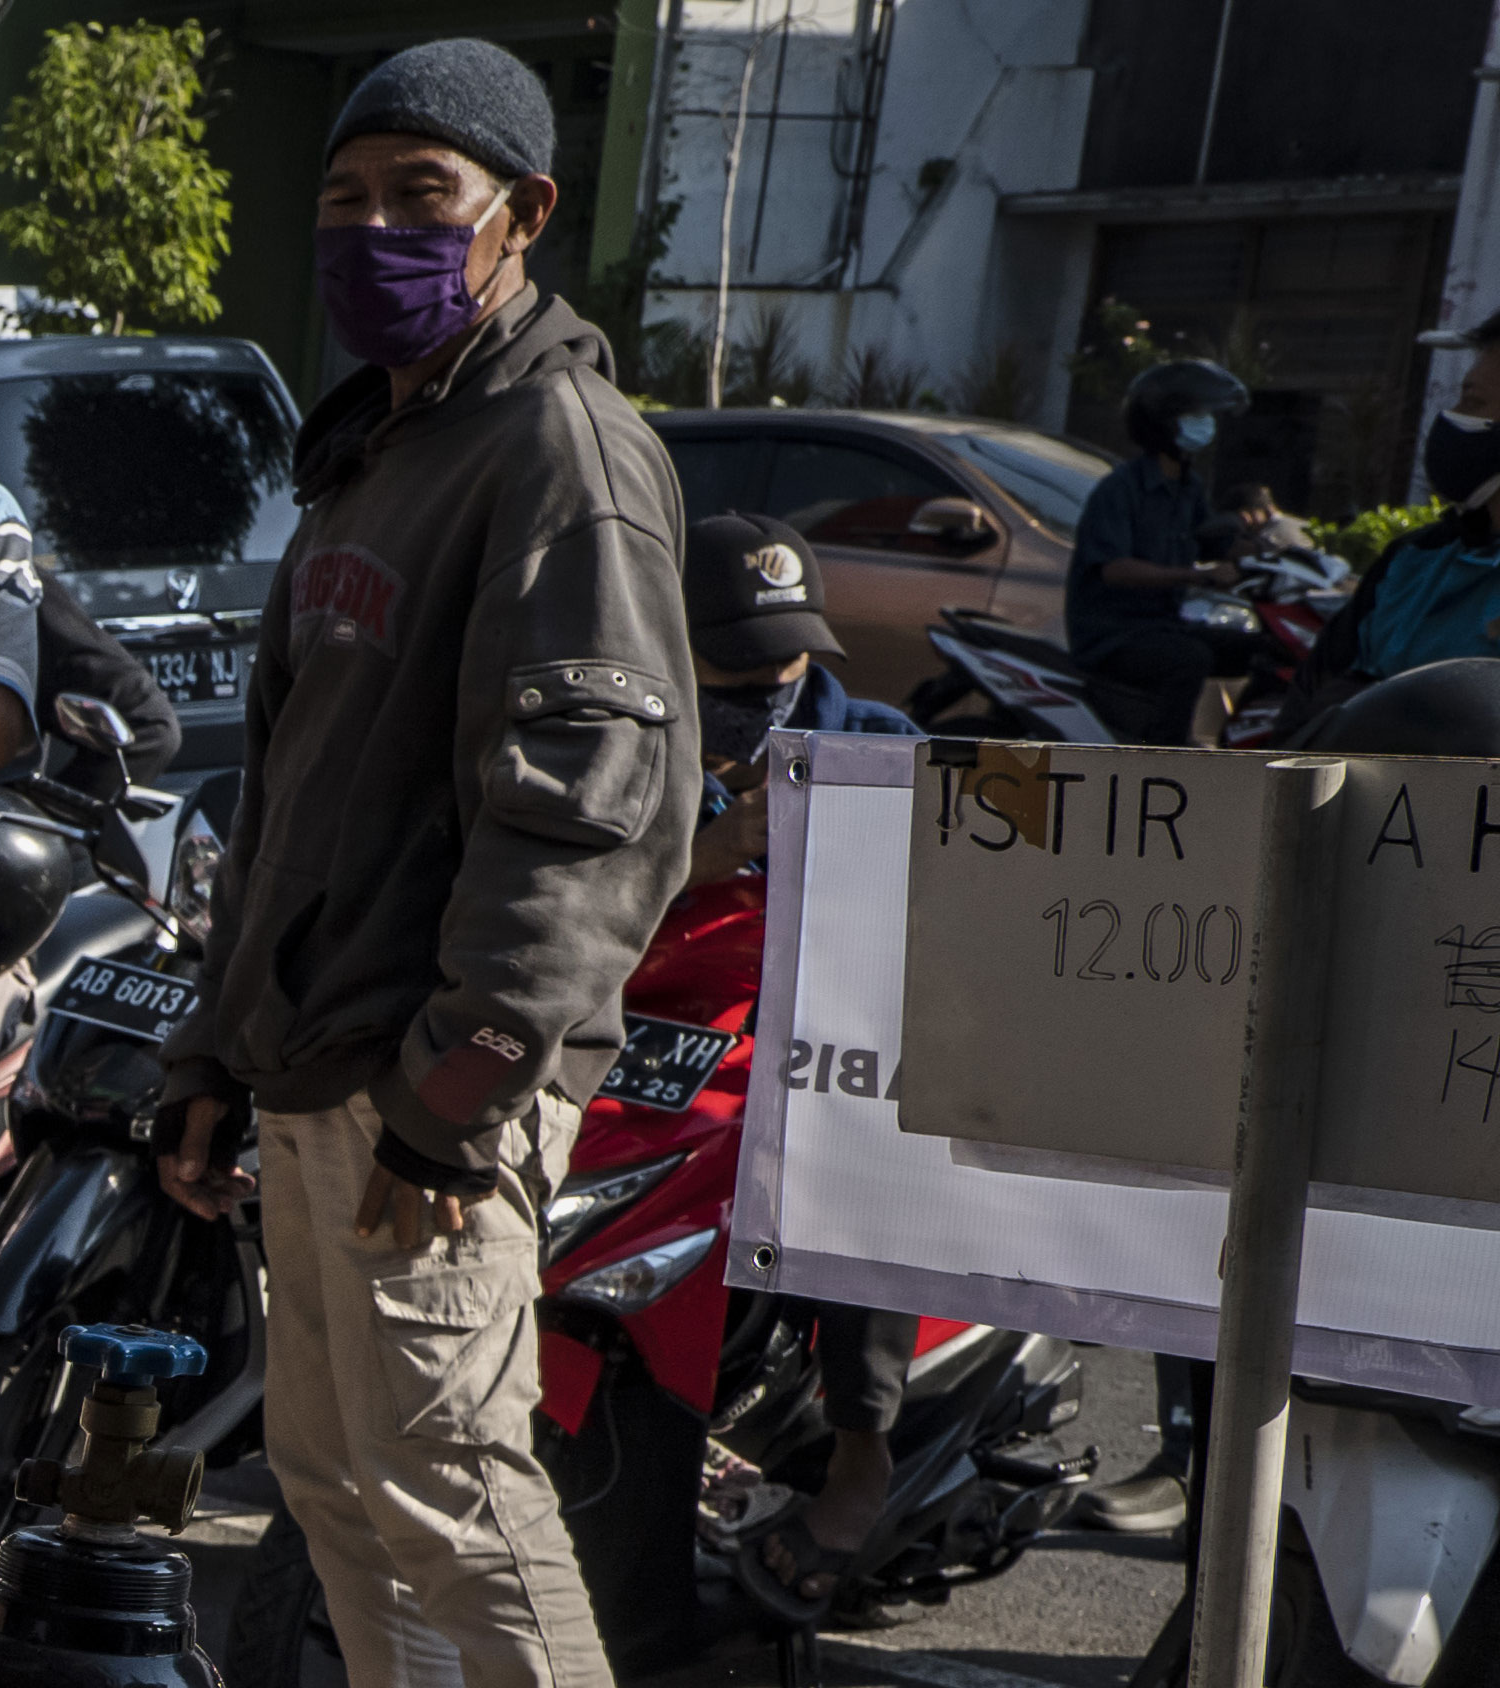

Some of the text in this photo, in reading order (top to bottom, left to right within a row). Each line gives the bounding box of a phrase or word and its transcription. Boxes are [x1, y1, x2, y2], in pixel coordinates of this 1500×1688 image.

[1042, 898, 1242, 985] 12.00
[70, 964, 186, 1015] AB 6013
[661, 1032, 722, 1070] XH
